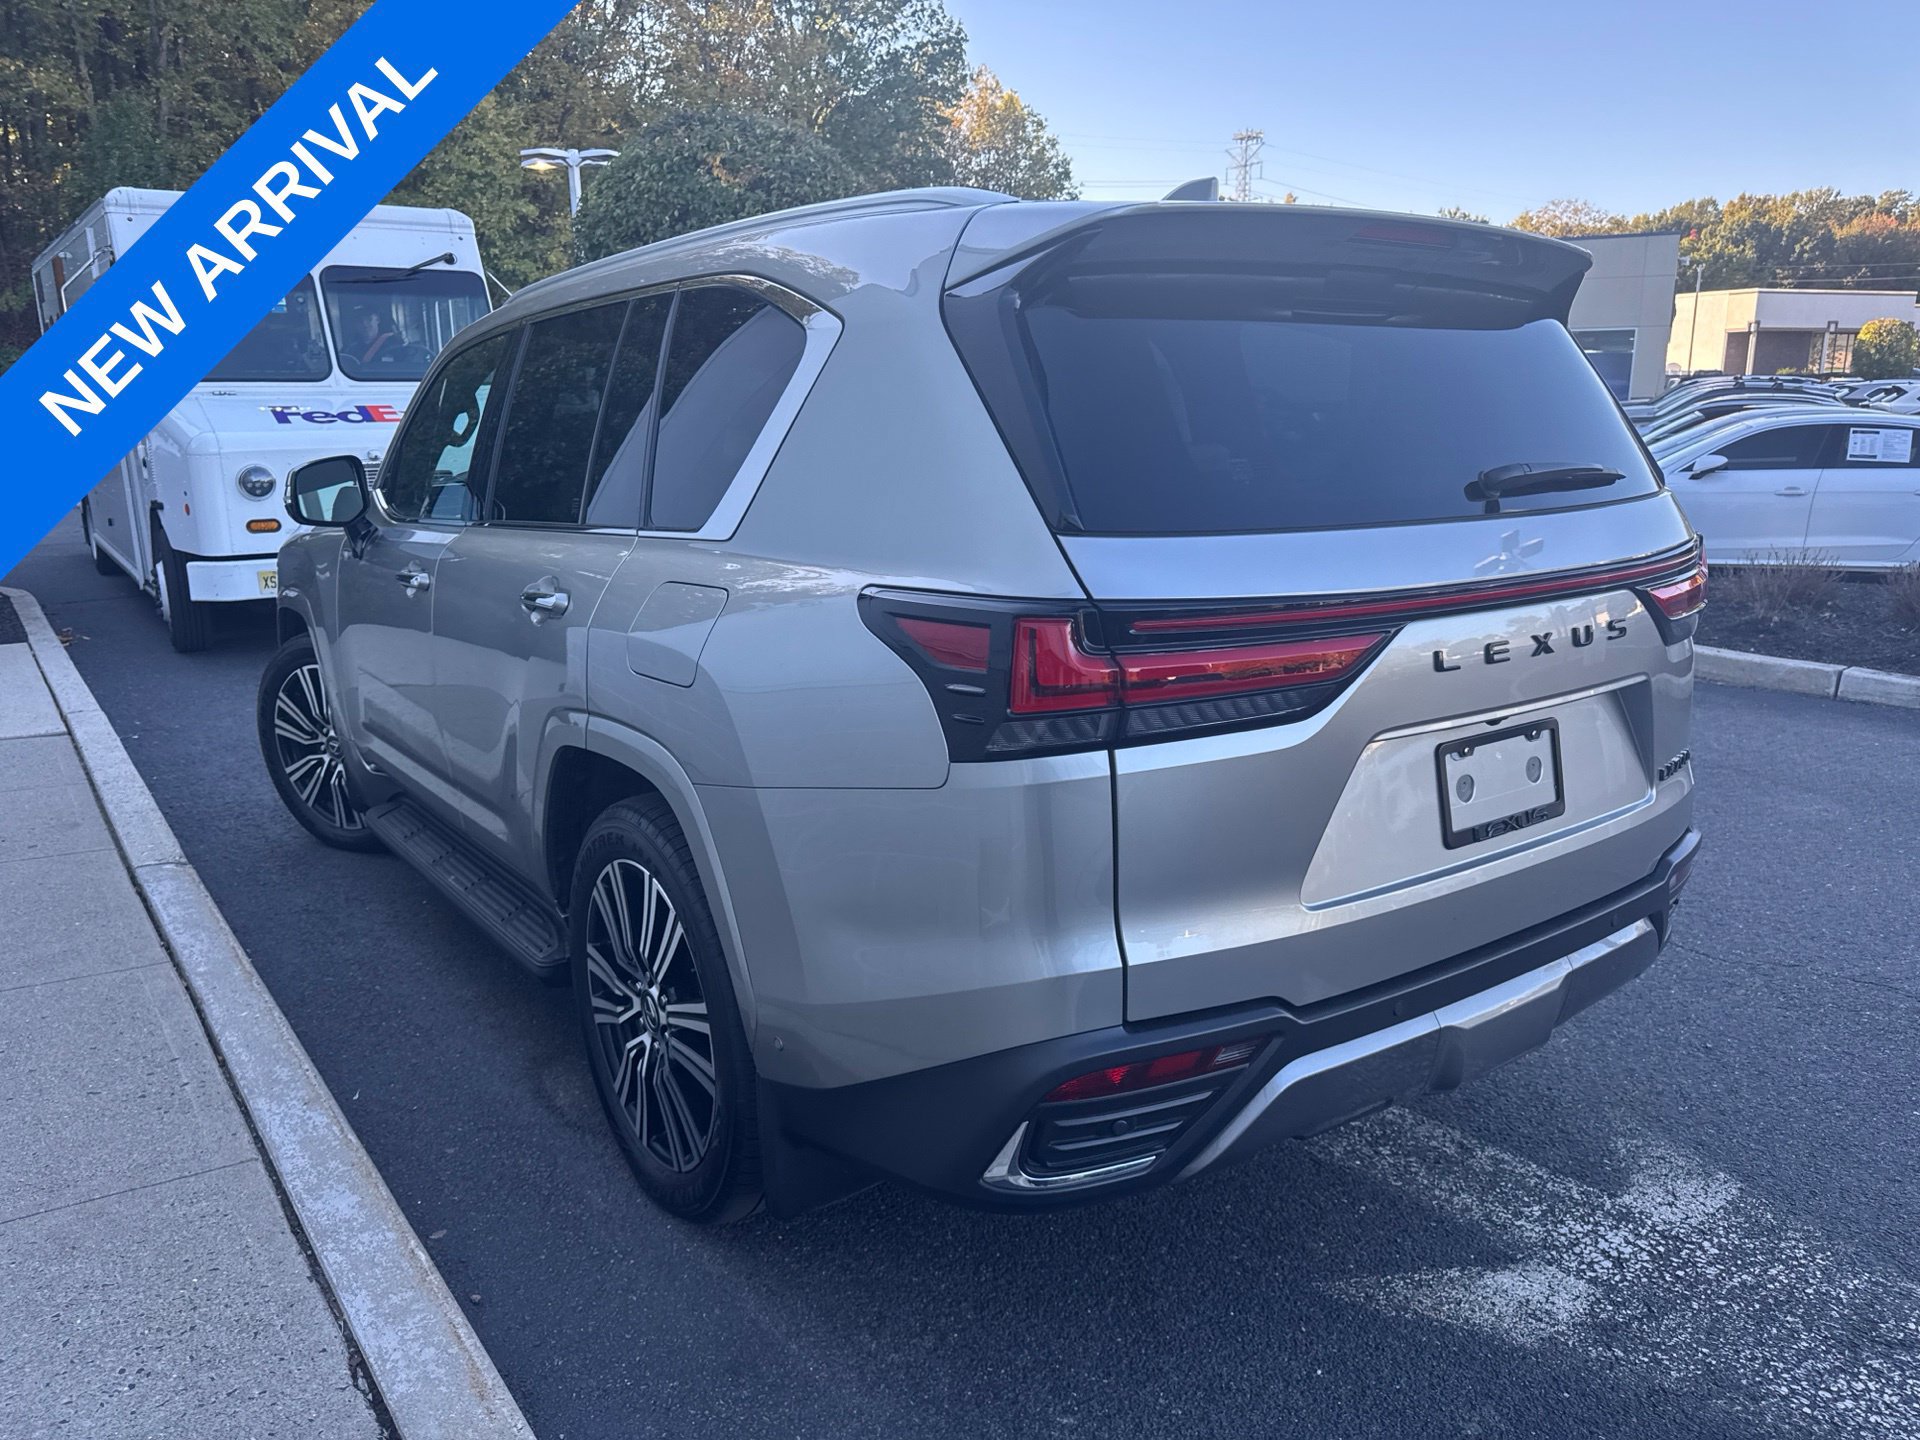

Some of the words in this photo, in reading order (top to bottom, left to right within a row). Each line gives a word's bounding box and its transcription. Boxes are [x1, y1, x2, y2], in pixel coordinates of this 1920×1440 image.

[268, 405, 406, 424] FedE
[1433, 619, 1627, 673] LEXUS
[1472, 807, 1549, 842] LEXUS
